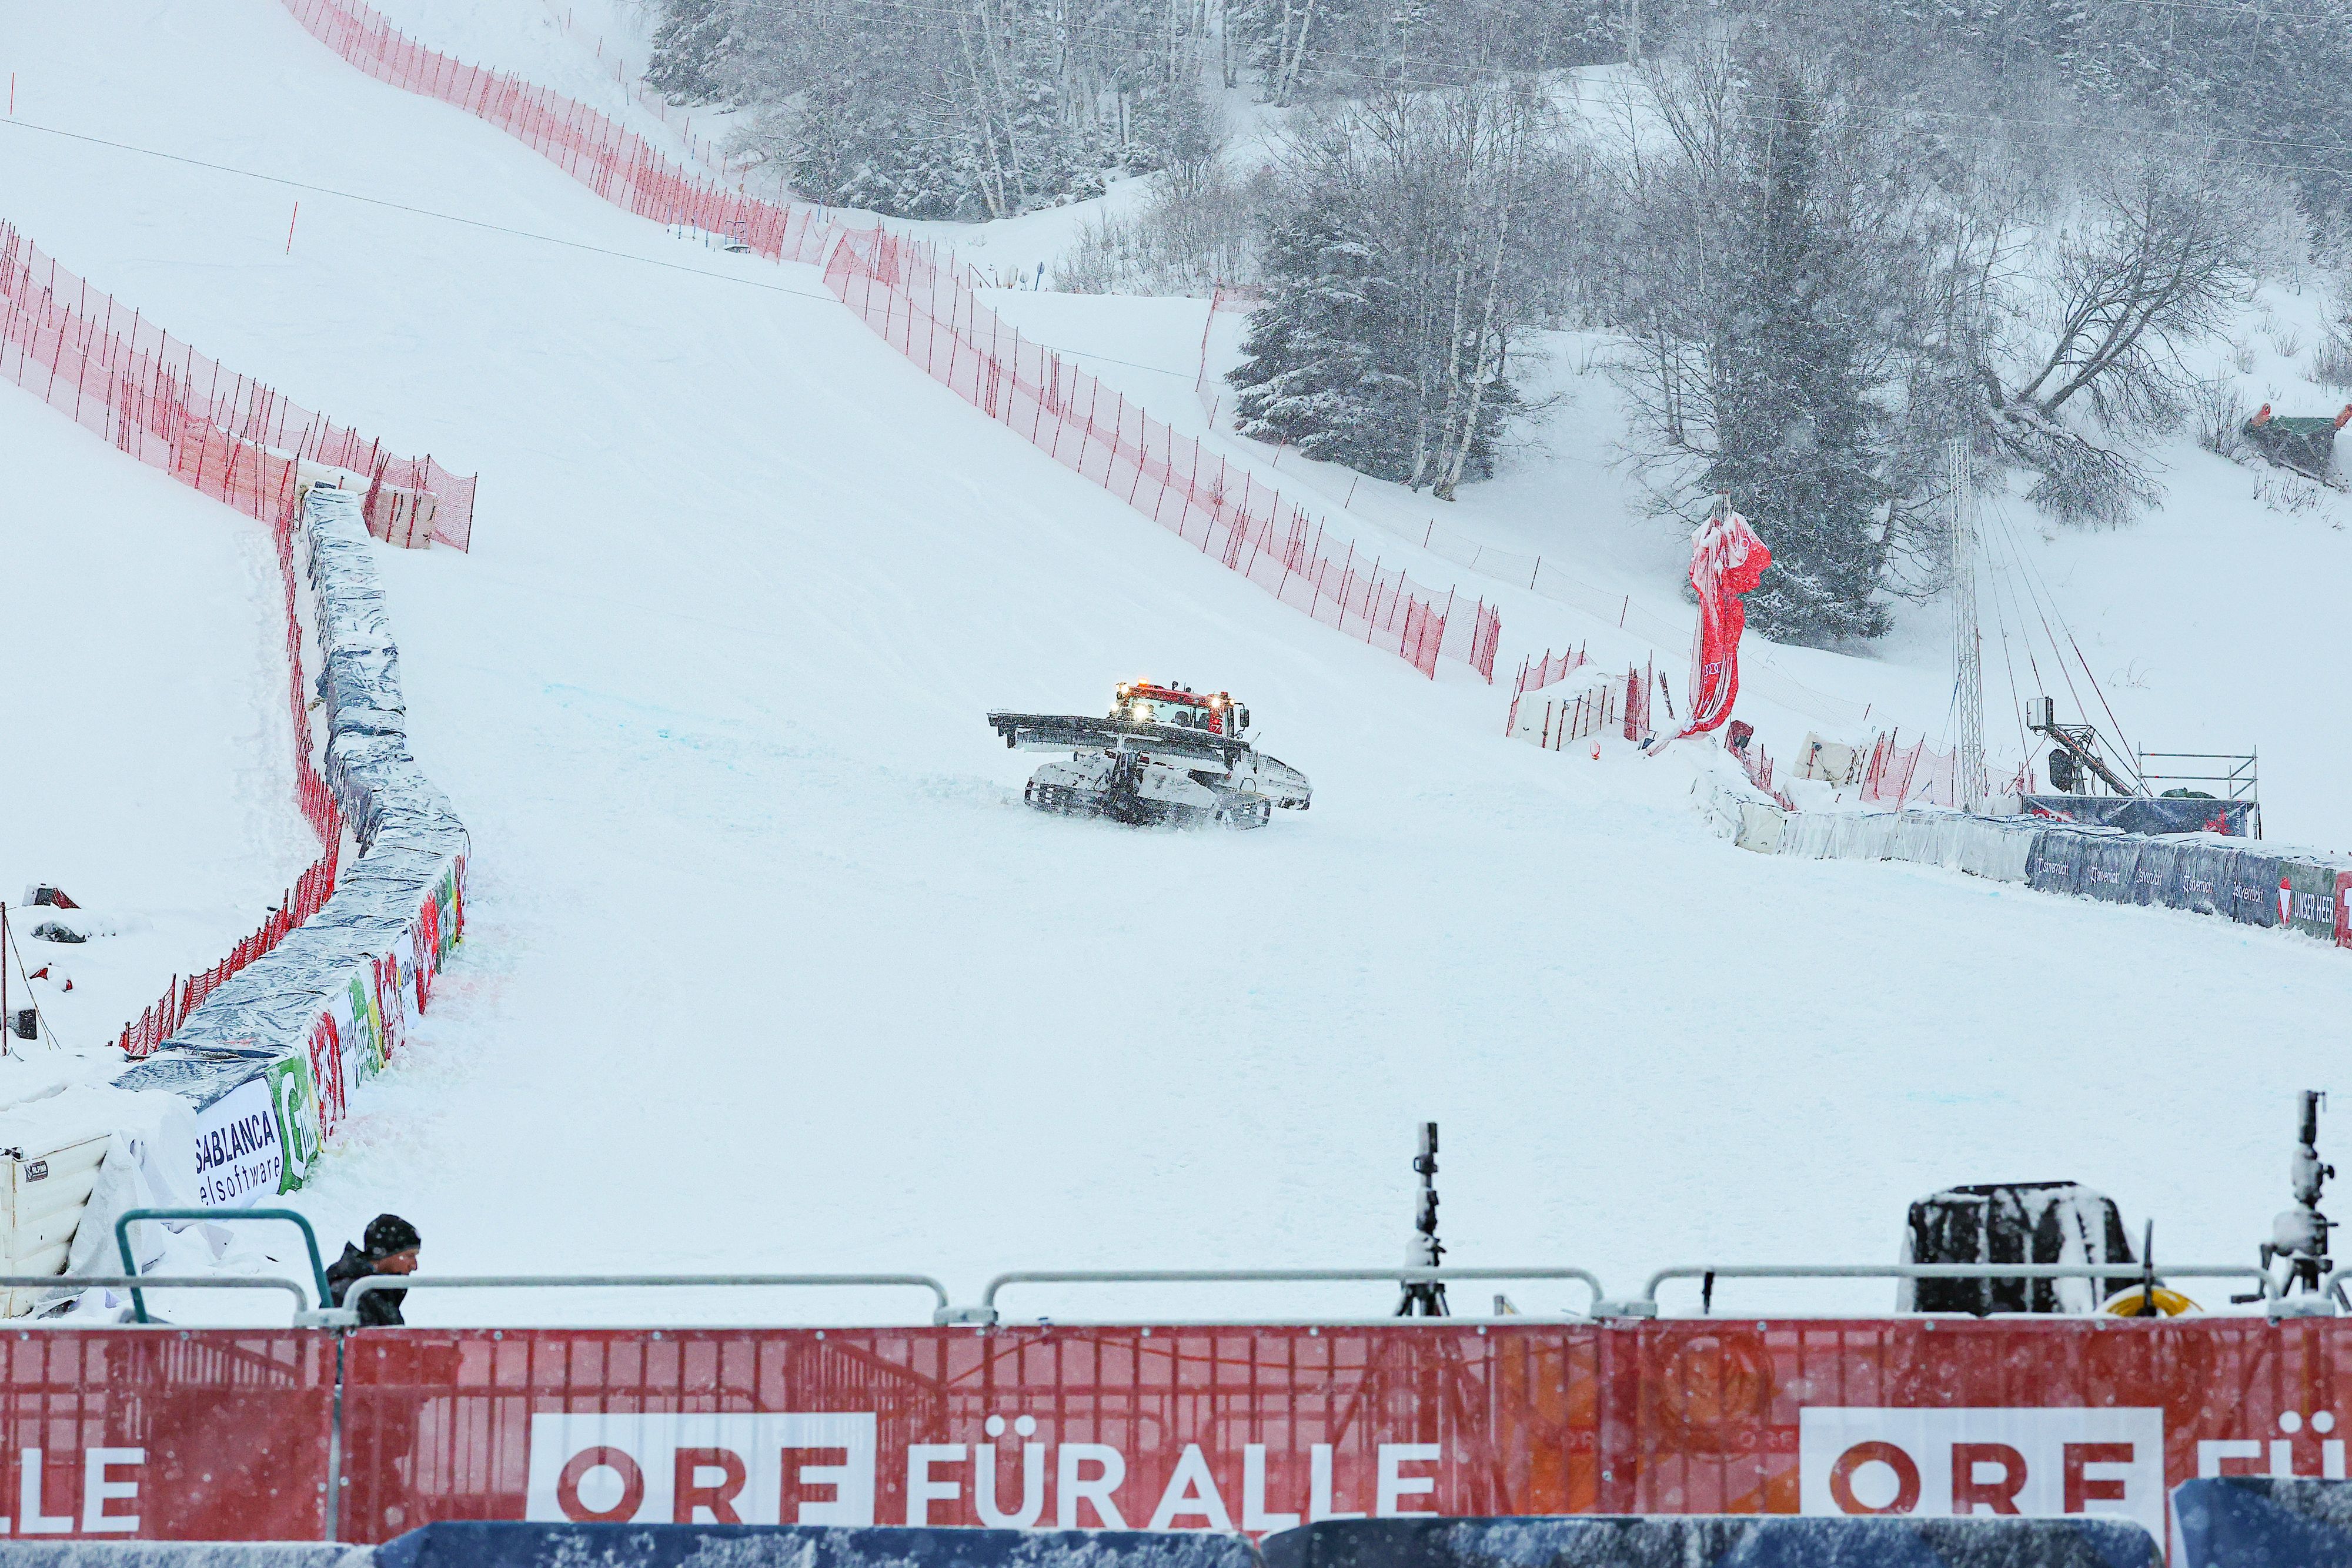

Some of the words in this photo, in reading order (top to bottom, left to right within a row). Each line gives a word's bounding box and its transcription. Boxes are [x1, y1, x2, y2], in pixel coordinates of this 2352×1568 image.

[2294, 891, 2316, 921] UNSER
[2316, 894, 2333, 924] HEER
[31, 1164, 47, 1174] ALPINA
[0, 1447, 145, 1533] LE
[557, 1446, 847, 1524] ORF
[906, 1415, 1128, 1530] FÜR
[1148, 1443, 1441, 1530] ALLE
[1830, 1440, 2134, 1515] ORF
